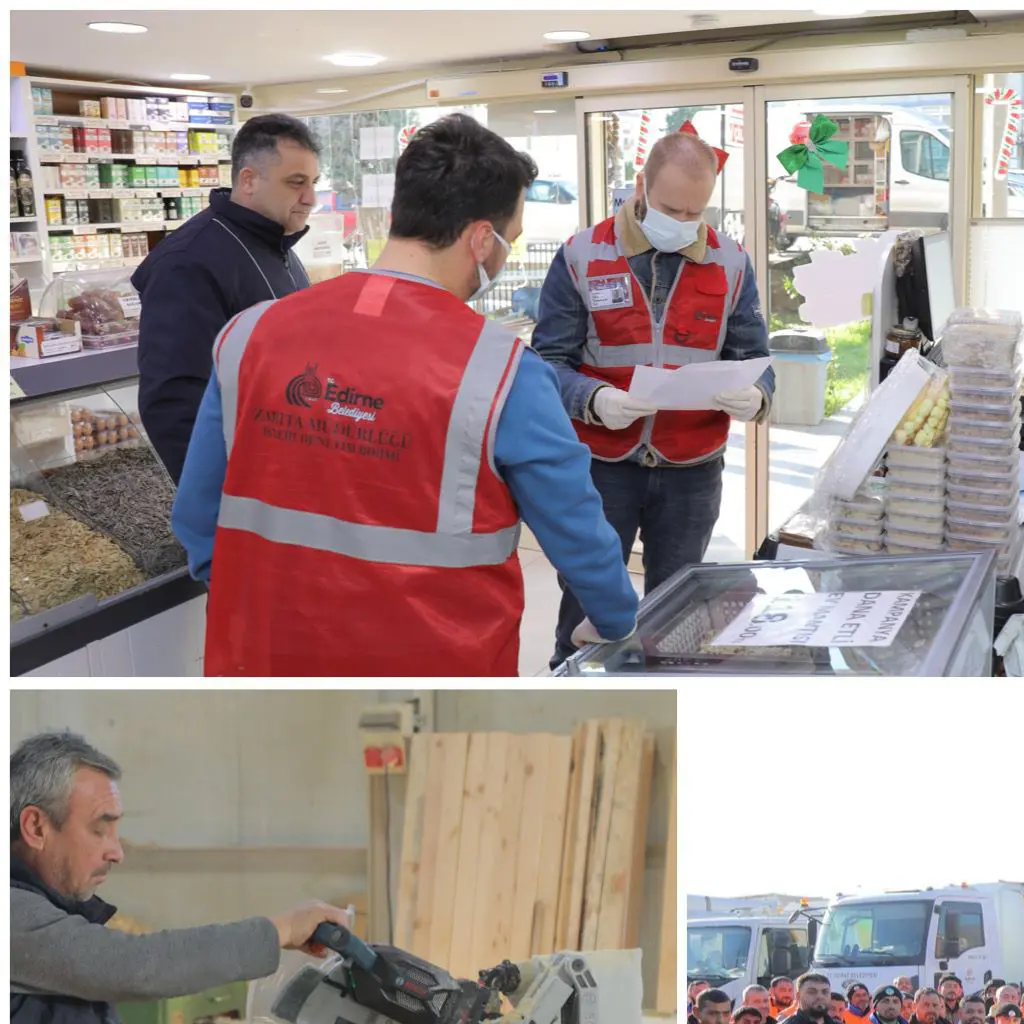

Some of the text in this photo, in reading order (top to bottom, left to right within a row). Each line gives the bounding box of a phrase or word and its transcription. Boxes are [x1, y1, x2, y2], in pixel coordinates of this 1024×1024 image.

[324, 382, 385, 410] Edirne
[327, 402, 377, 422] Belediyesi
[849, 592, 881, 620] DANA
[868, 592, 914, 642] KAMPANYA
